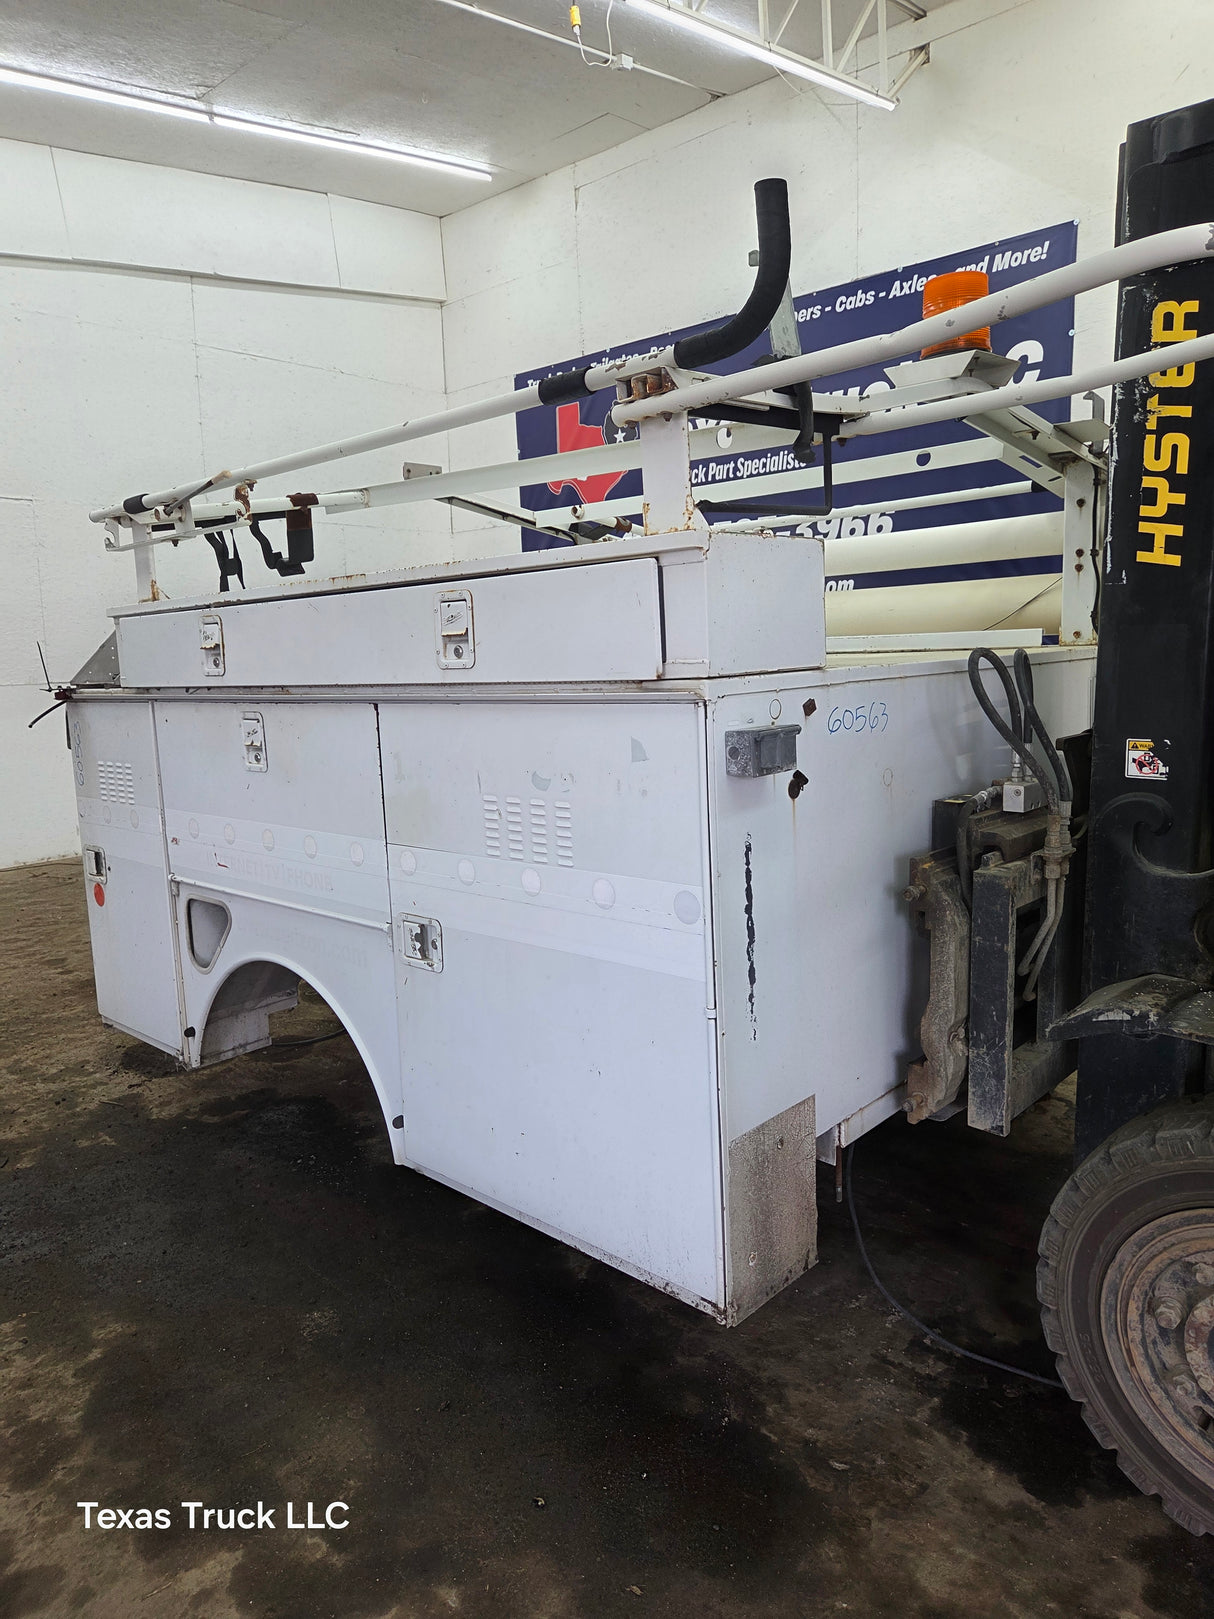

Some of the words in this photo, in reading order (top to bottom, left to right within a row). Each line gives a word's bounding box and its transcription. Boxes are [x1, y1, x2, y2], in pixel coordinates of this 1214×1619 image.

[835, 291, 875, 313] Cabs
[992, 241, 1051, 272] More!
[708, 460, 735, 481] Part
[827, 701, 889, 735] 60563
